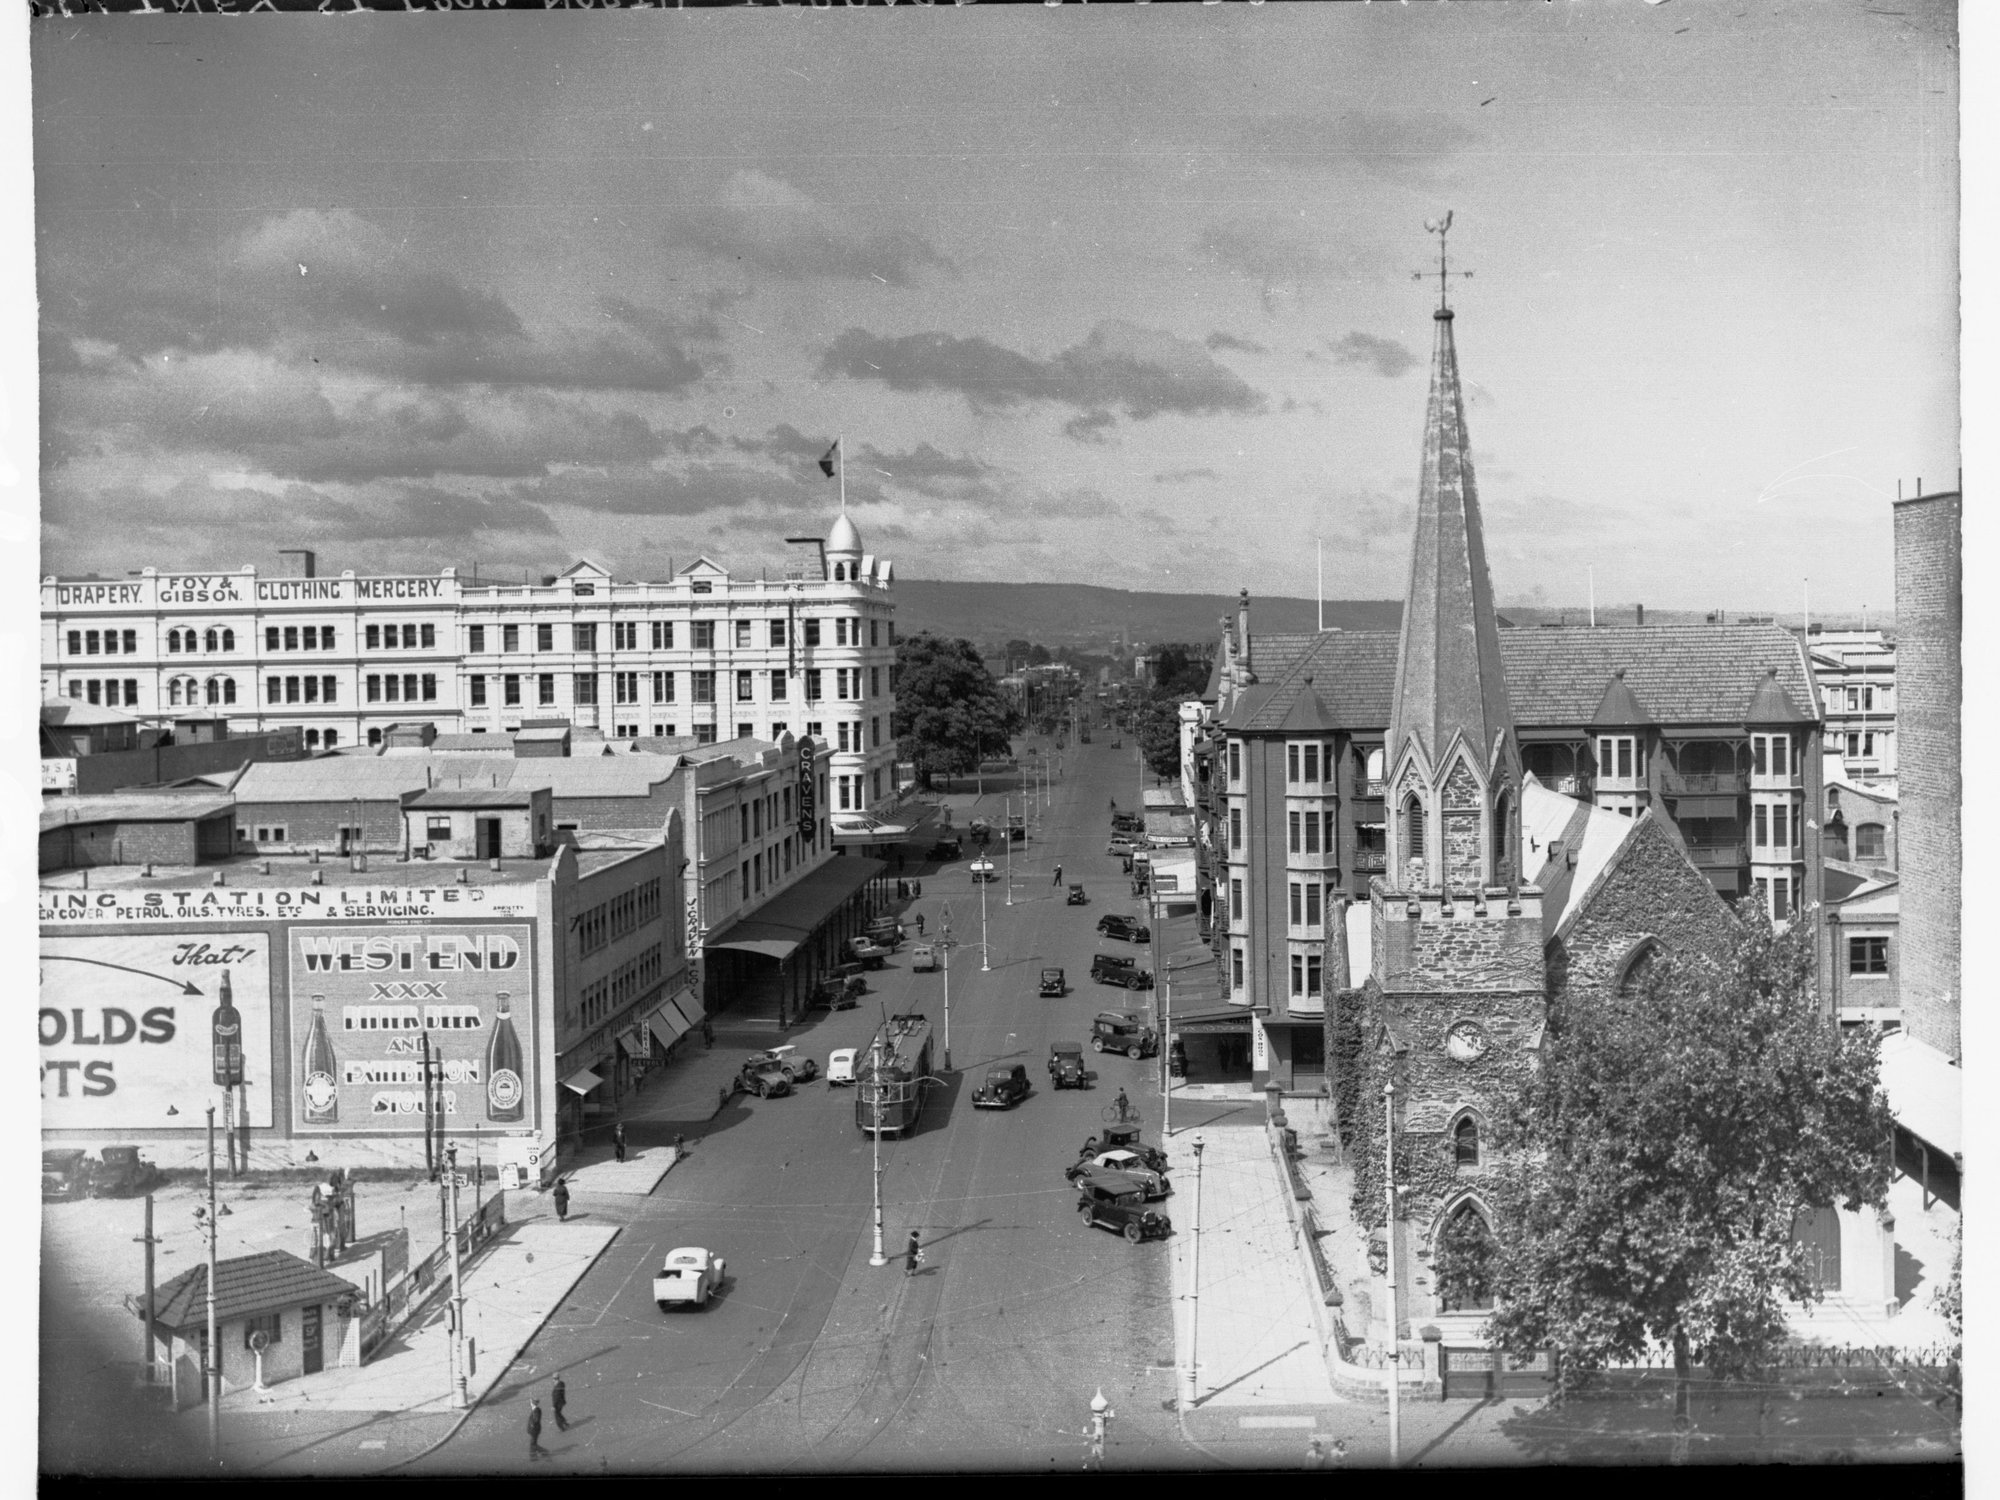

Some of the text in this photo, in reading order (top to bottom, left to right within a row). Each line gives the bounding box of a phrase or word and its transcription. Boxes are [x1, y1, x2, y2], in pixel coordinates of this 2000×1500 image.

[169, 577, 232, 590] FOY &
[358, 579, 442, 598] MERCERY.
[60, 586, 143, 604] DRAPERY.
[160, 590, 242, 602] GIBSON.
[800, 747, 813, 831] CRAVENS
[39, 889, 485, 908] ING STATION LIMITED
[327, 905, 338, 917] &
[344, 904, 435, 917] SERVICING.
[172, 943, 256, 966] That!
[299, 935, 521, 973] WEST END
[369, 981, 448, 1000] XXX
[343, 1005, 484, 1031] BITTER BEER
[385, 1037, 431, 1054] AND
[39, 1061, 117, 1099] TS
